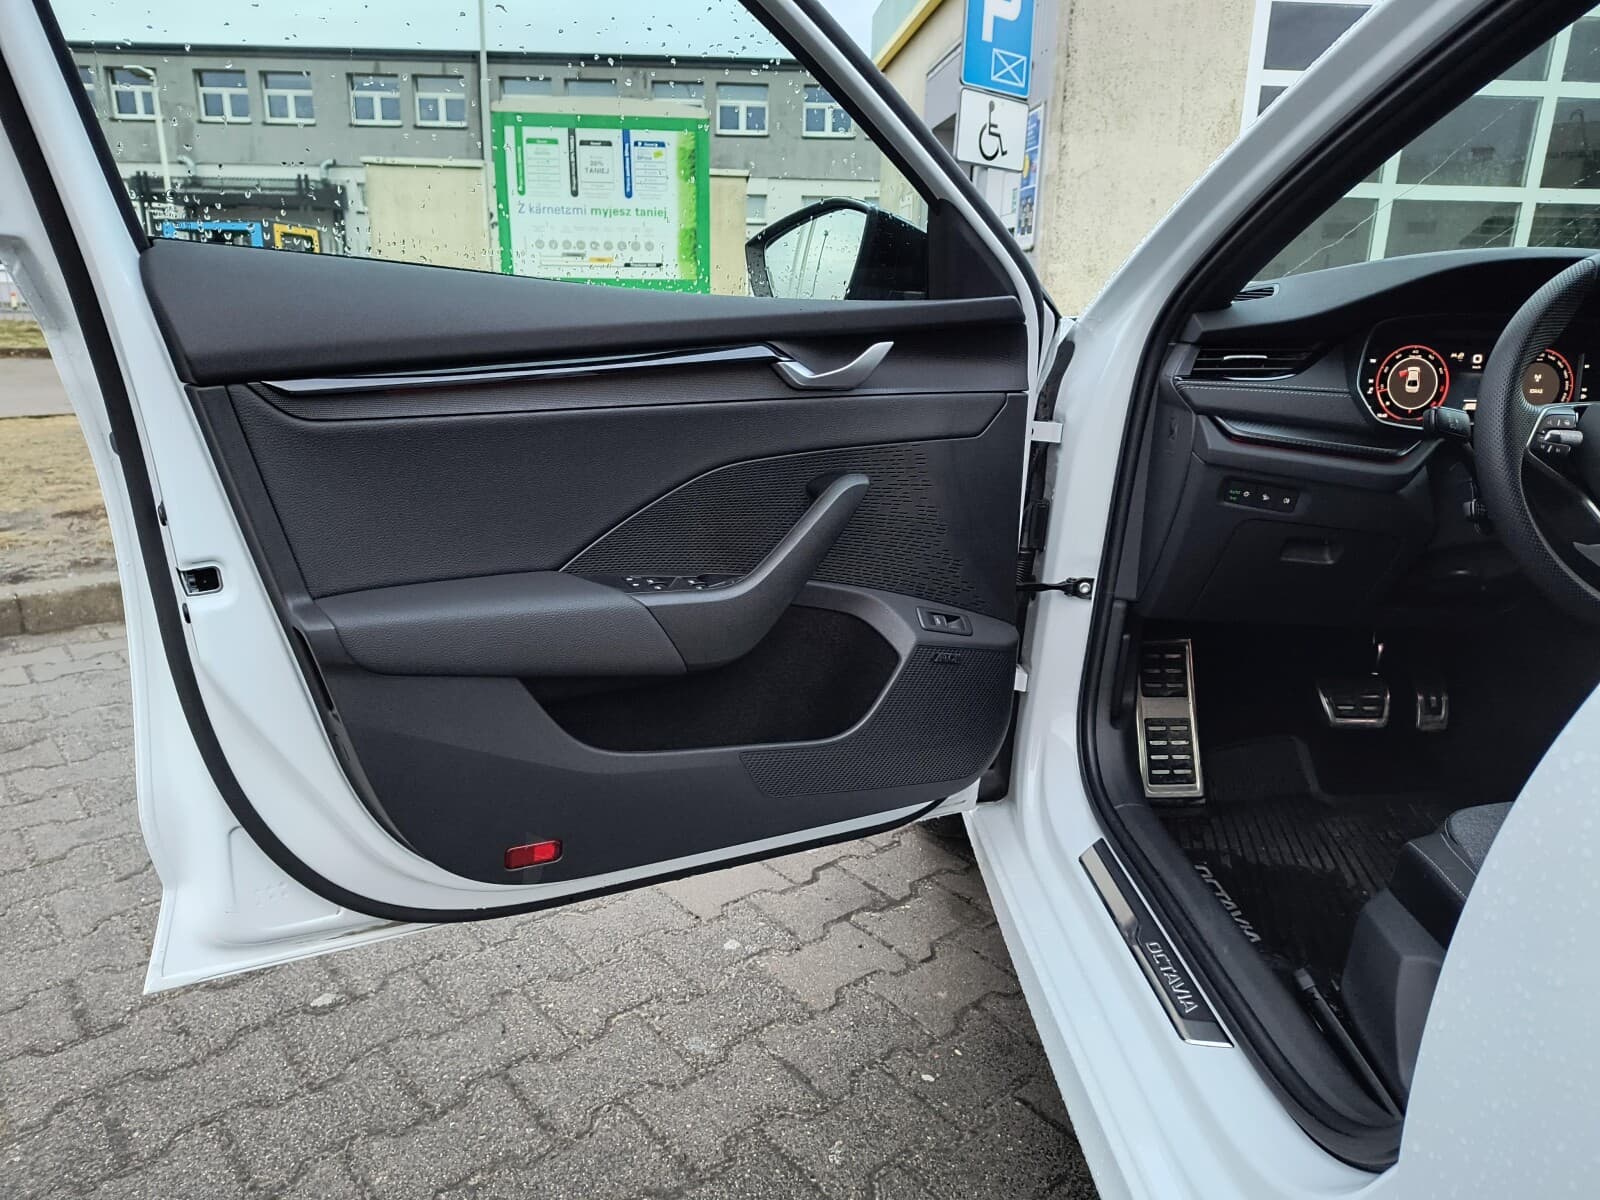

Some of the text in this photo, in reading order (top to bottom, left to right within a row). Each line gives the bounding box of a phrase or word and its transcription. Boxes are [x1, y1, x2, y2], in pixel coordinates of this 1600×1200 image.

[981, 0, 1022, 42] P
[590, 206, 631, 219] myjesz
[635, 207, 668, 220] taniej
[1145, 942, 1199, 1014] OCTAVIA
